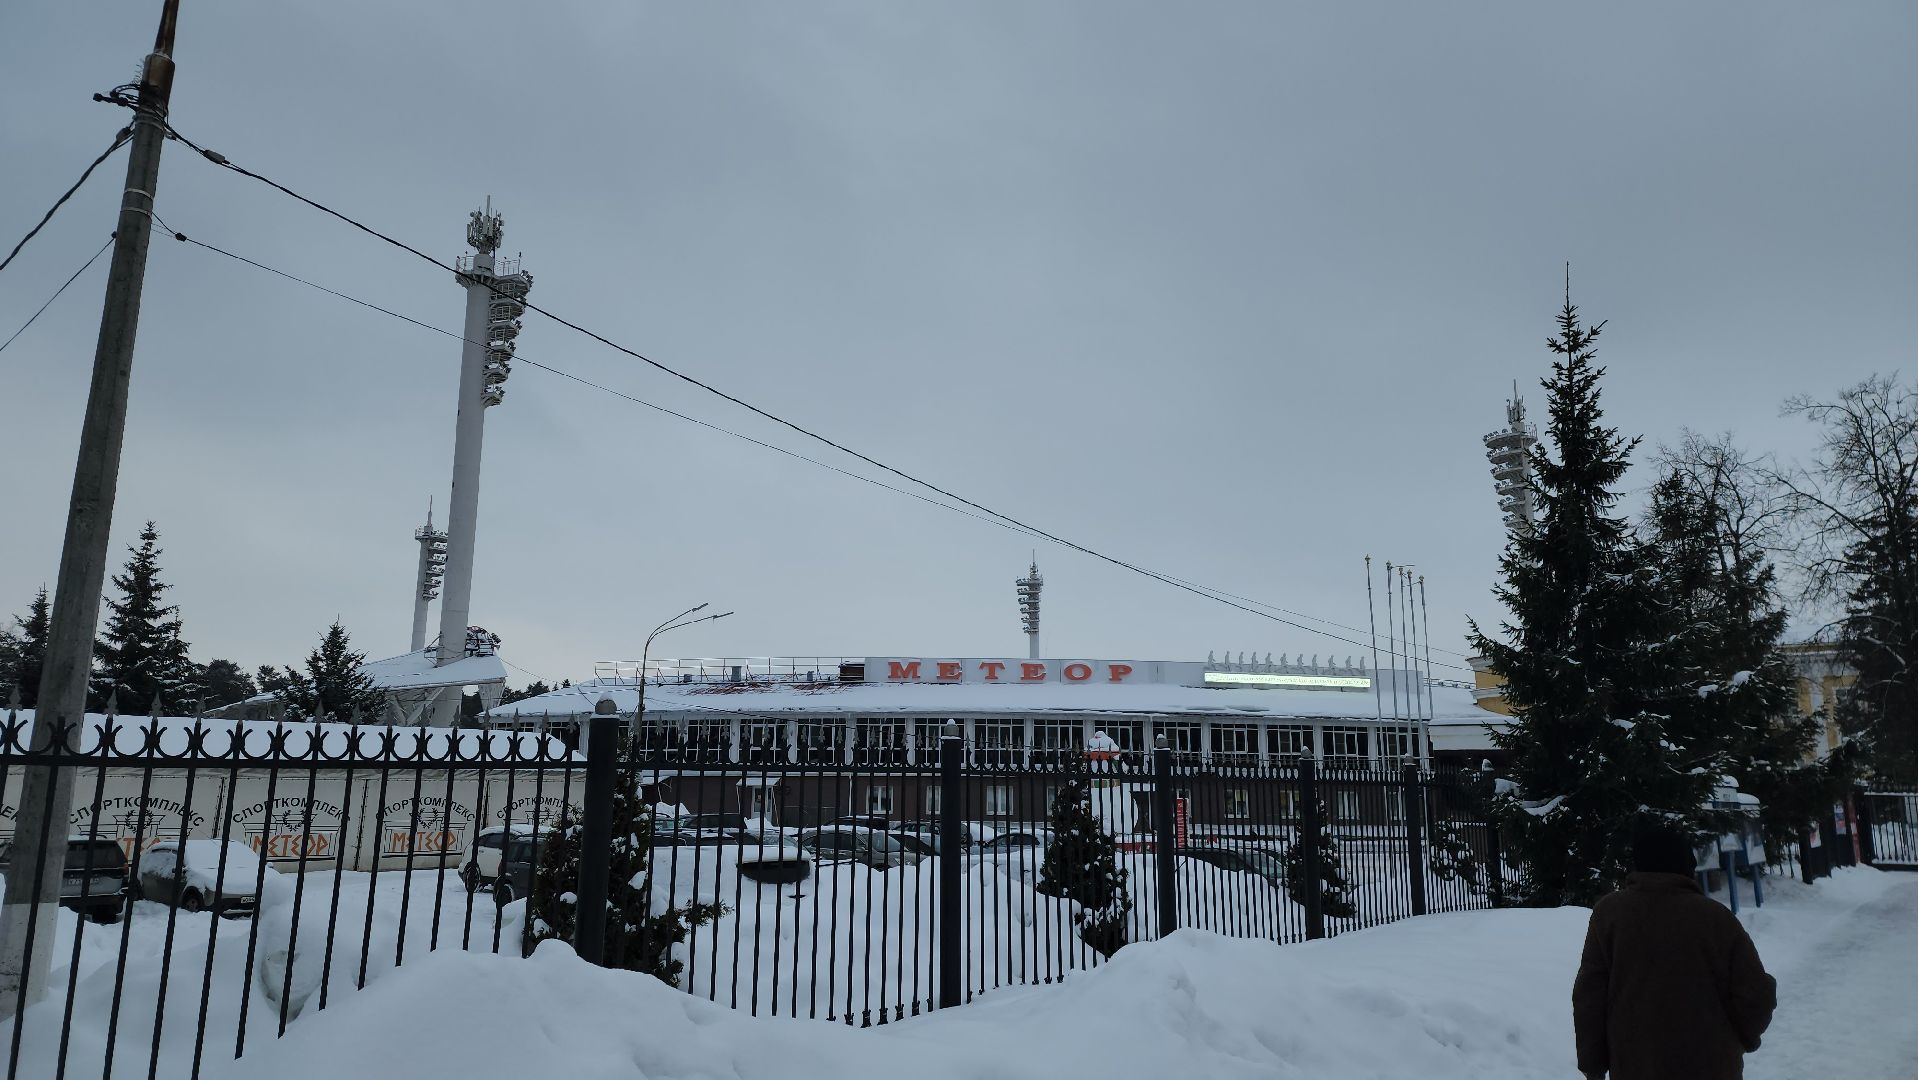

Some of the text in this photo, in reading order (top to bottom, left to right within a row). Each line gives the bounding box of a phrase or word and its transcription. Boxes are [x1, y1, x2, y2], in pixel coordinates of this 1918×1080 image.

[888, 661, 1133, 683] МЕТЕОР
[232, 797, 351, 824] СПОТКОМПЛЕК
[392, 831, 457, 853] МТЕОР
